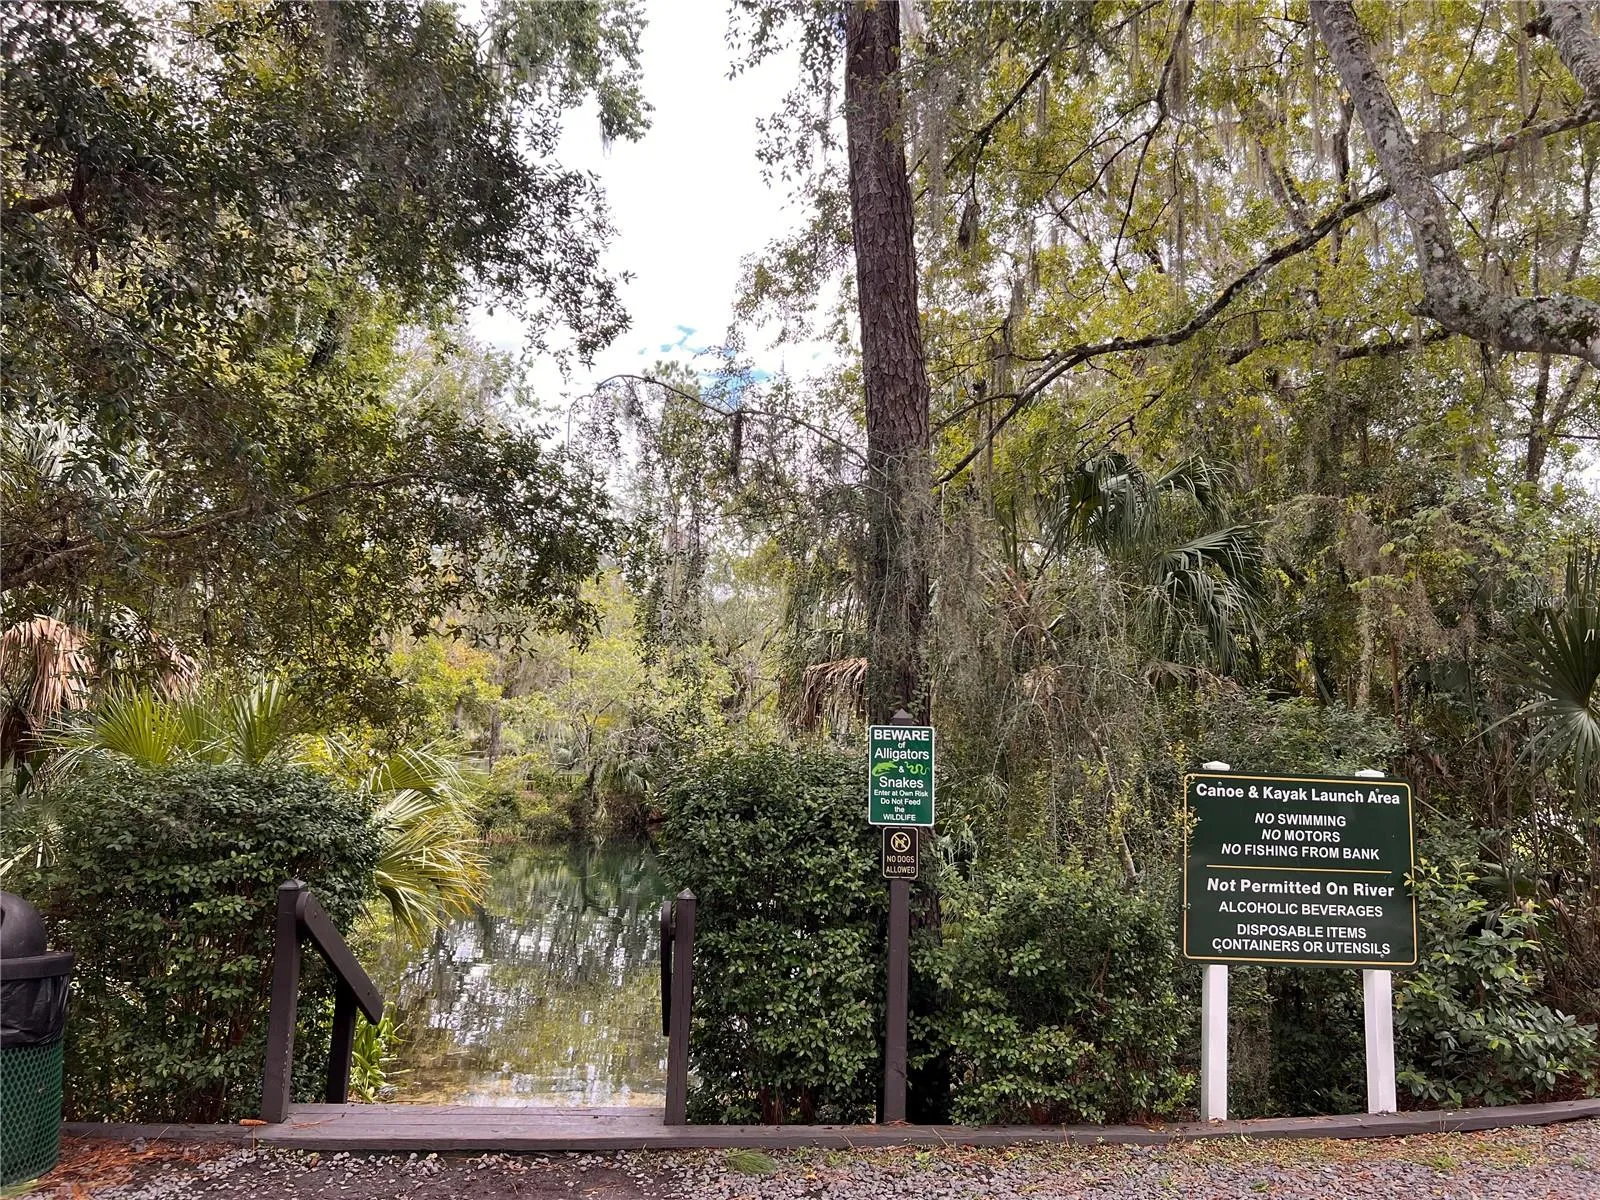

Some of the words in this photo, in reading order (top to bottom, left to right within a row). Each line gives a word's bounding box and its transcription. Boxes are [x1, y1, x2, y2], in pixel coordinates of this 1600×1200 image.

[874, 730, 930, 740] BEWARE
[874, 748, 930, 761] Alligators
[879, 776, 924, 788] Snakes
[1196, 784, 1244, 798] Canoe
[1248, 786, 1258, 798] &
[1263, 786, 1308, 801] Kayak
[1312, 788, 1364, 802] Launch
[1368, 791, 1400, 804] Area
[1255, 812, 1274, 824] NO
[1278, 814, 1346, 827] SWIMMING
[1262, 829, 1282, 840] NO
[1284, 830, 1340, 842] MOTORS
[1221, 843, 1242, 854] NO
[1244, 844, 1298, 857] FISHING
[1302, 846, 1340, 859] FROM
[1343, 848, 1380, 860] BANK
[1207, 878, 1236, 892] Not
[1240, 879, 1321, 894] Permitted
[1326, 882, 1348, 895] On
[1353, 883, 1394, 897] River
[1218, 901, 1298, 914] ALCOHOLIC
[1302, 904, 1383, 917] BEVERAGES
[1237, 924, 1323, 938] DISPOSABLE
[1327, 926, 1366, 939] ITEMS
[1212, 938, 1300, 952] CONTAINERS
[1303, 941, 1323, 952] OR
[1326, 942, 1390, 955] UTENSILS
